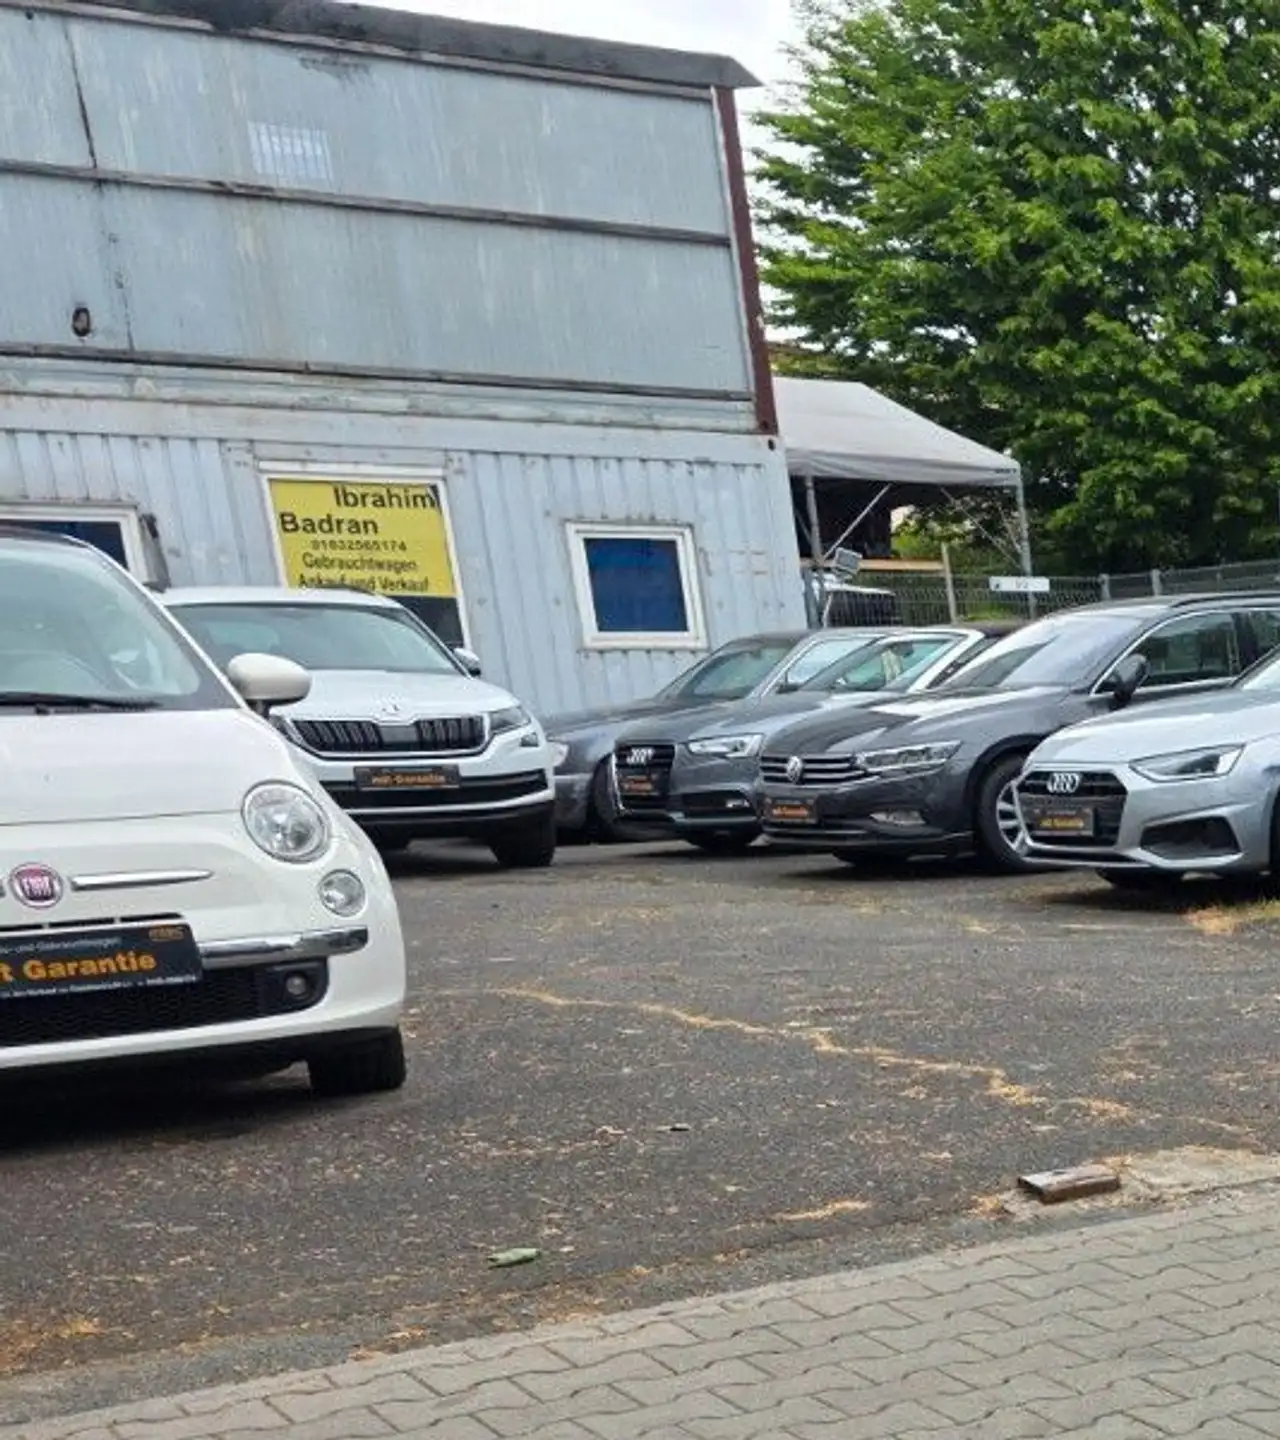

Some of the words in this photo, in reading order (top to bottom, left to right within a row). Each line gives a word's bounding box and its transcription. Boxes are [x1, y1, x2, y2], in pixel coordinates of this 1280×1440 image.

[333, 484, 435, 509] Ibrahim
[279, 512, 378, 534] Badran
[302, 552, 417, 574] Gebrauchtwagen
[378, 575, 429, 591] Verkauf
[22, 950, 157, 981] Garantie
